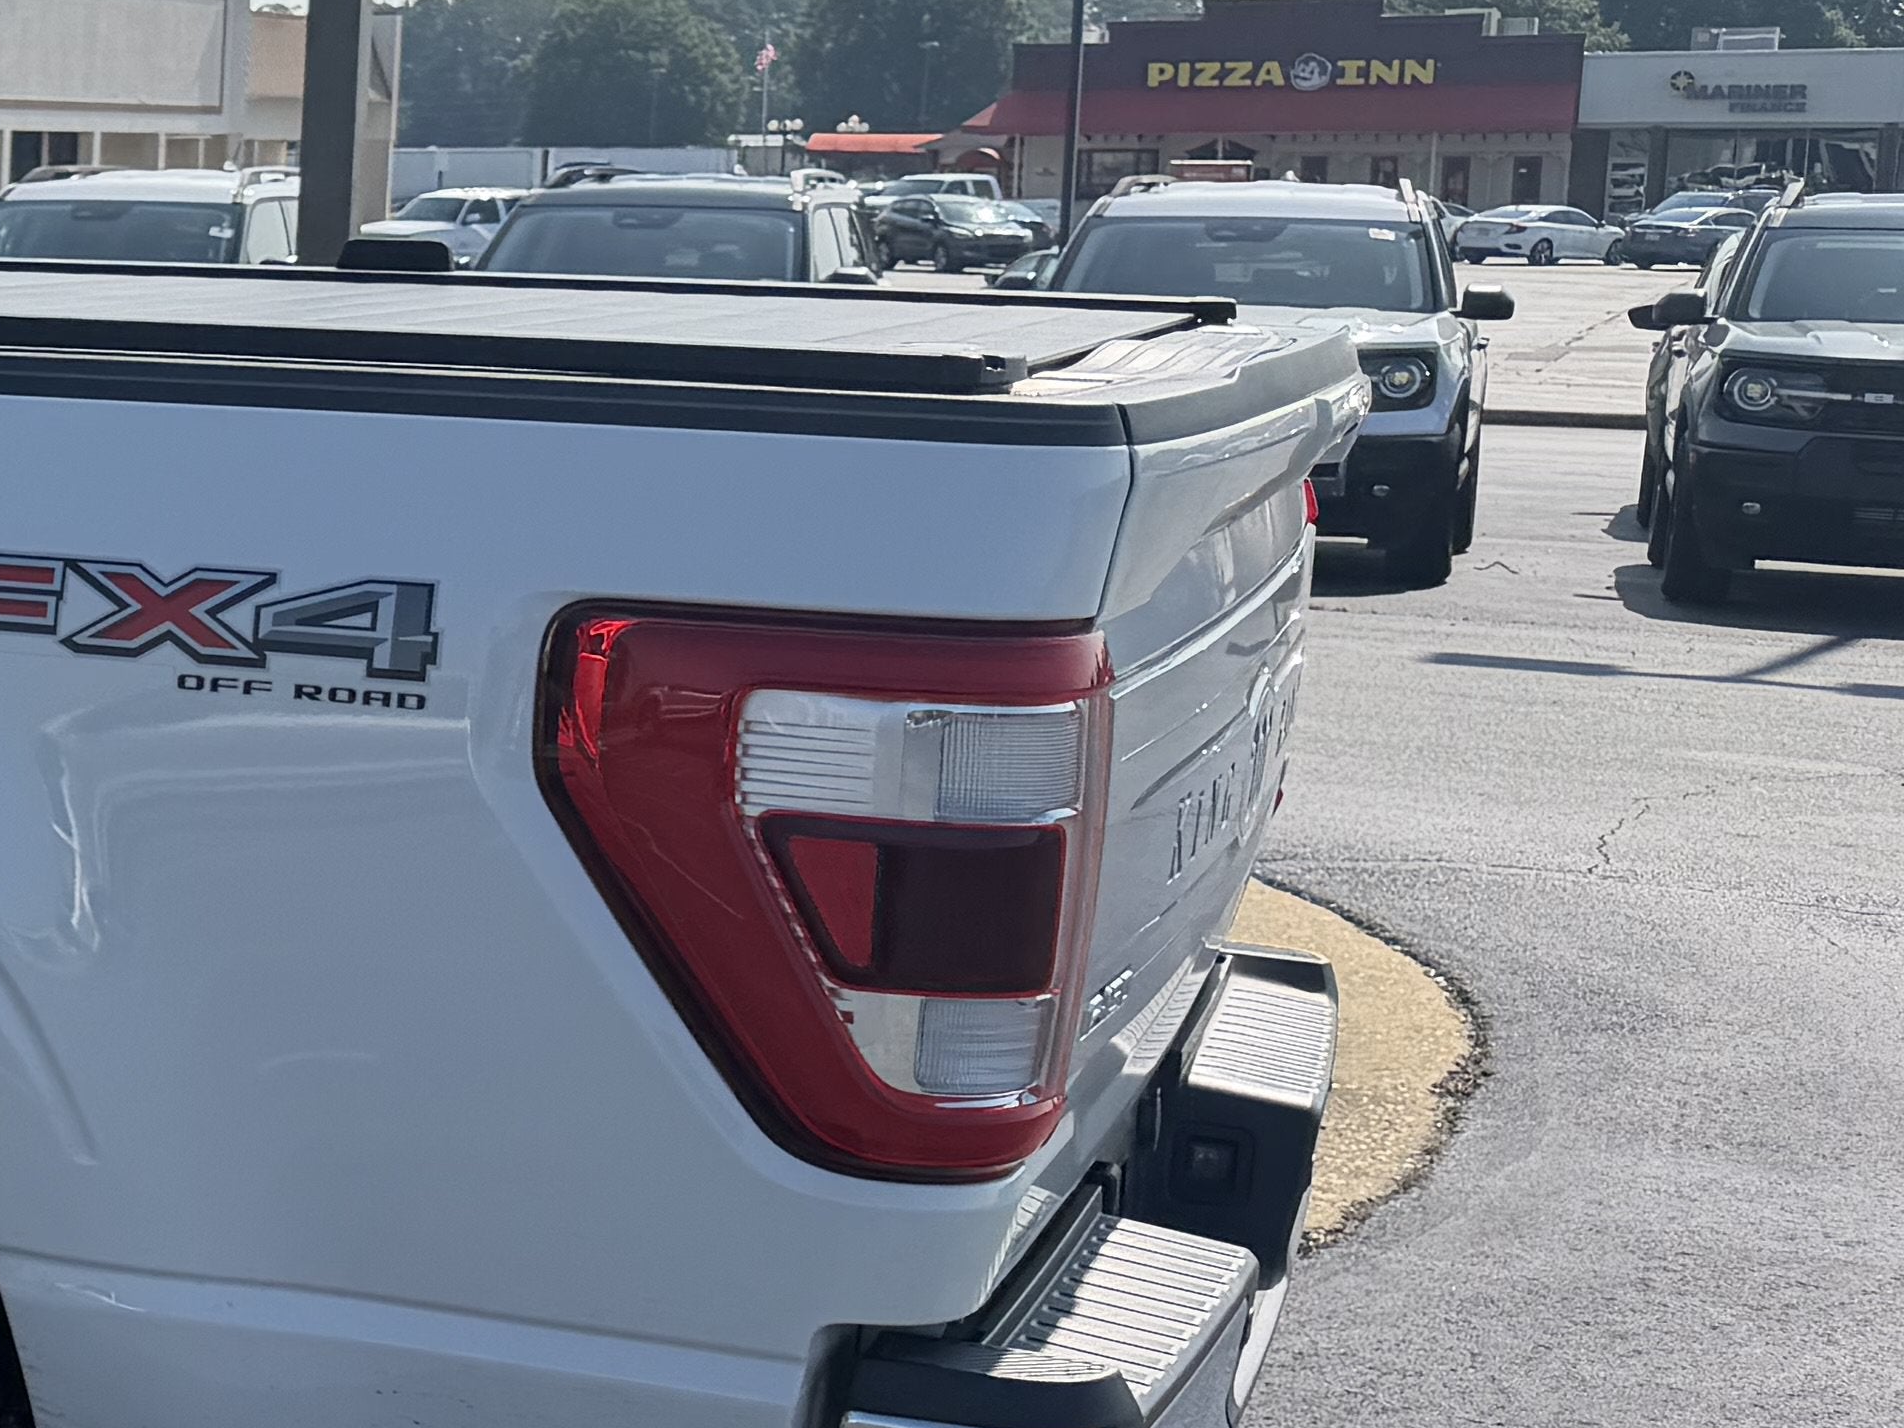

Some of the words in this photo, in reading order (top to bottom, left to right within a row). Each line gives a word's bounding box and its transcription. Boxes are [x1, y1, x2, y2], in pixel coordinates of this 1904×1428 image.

[1146, 60, 1286, 88] PIZZA
[1335, 58, 1435, 86] INN
[1682, 84, 1808, 101] MARINER
[1728, 101, 1808, 114] FINANCE
[176, 672, 274, 697] OFF
[293, 682, 427, 712] ROAD
